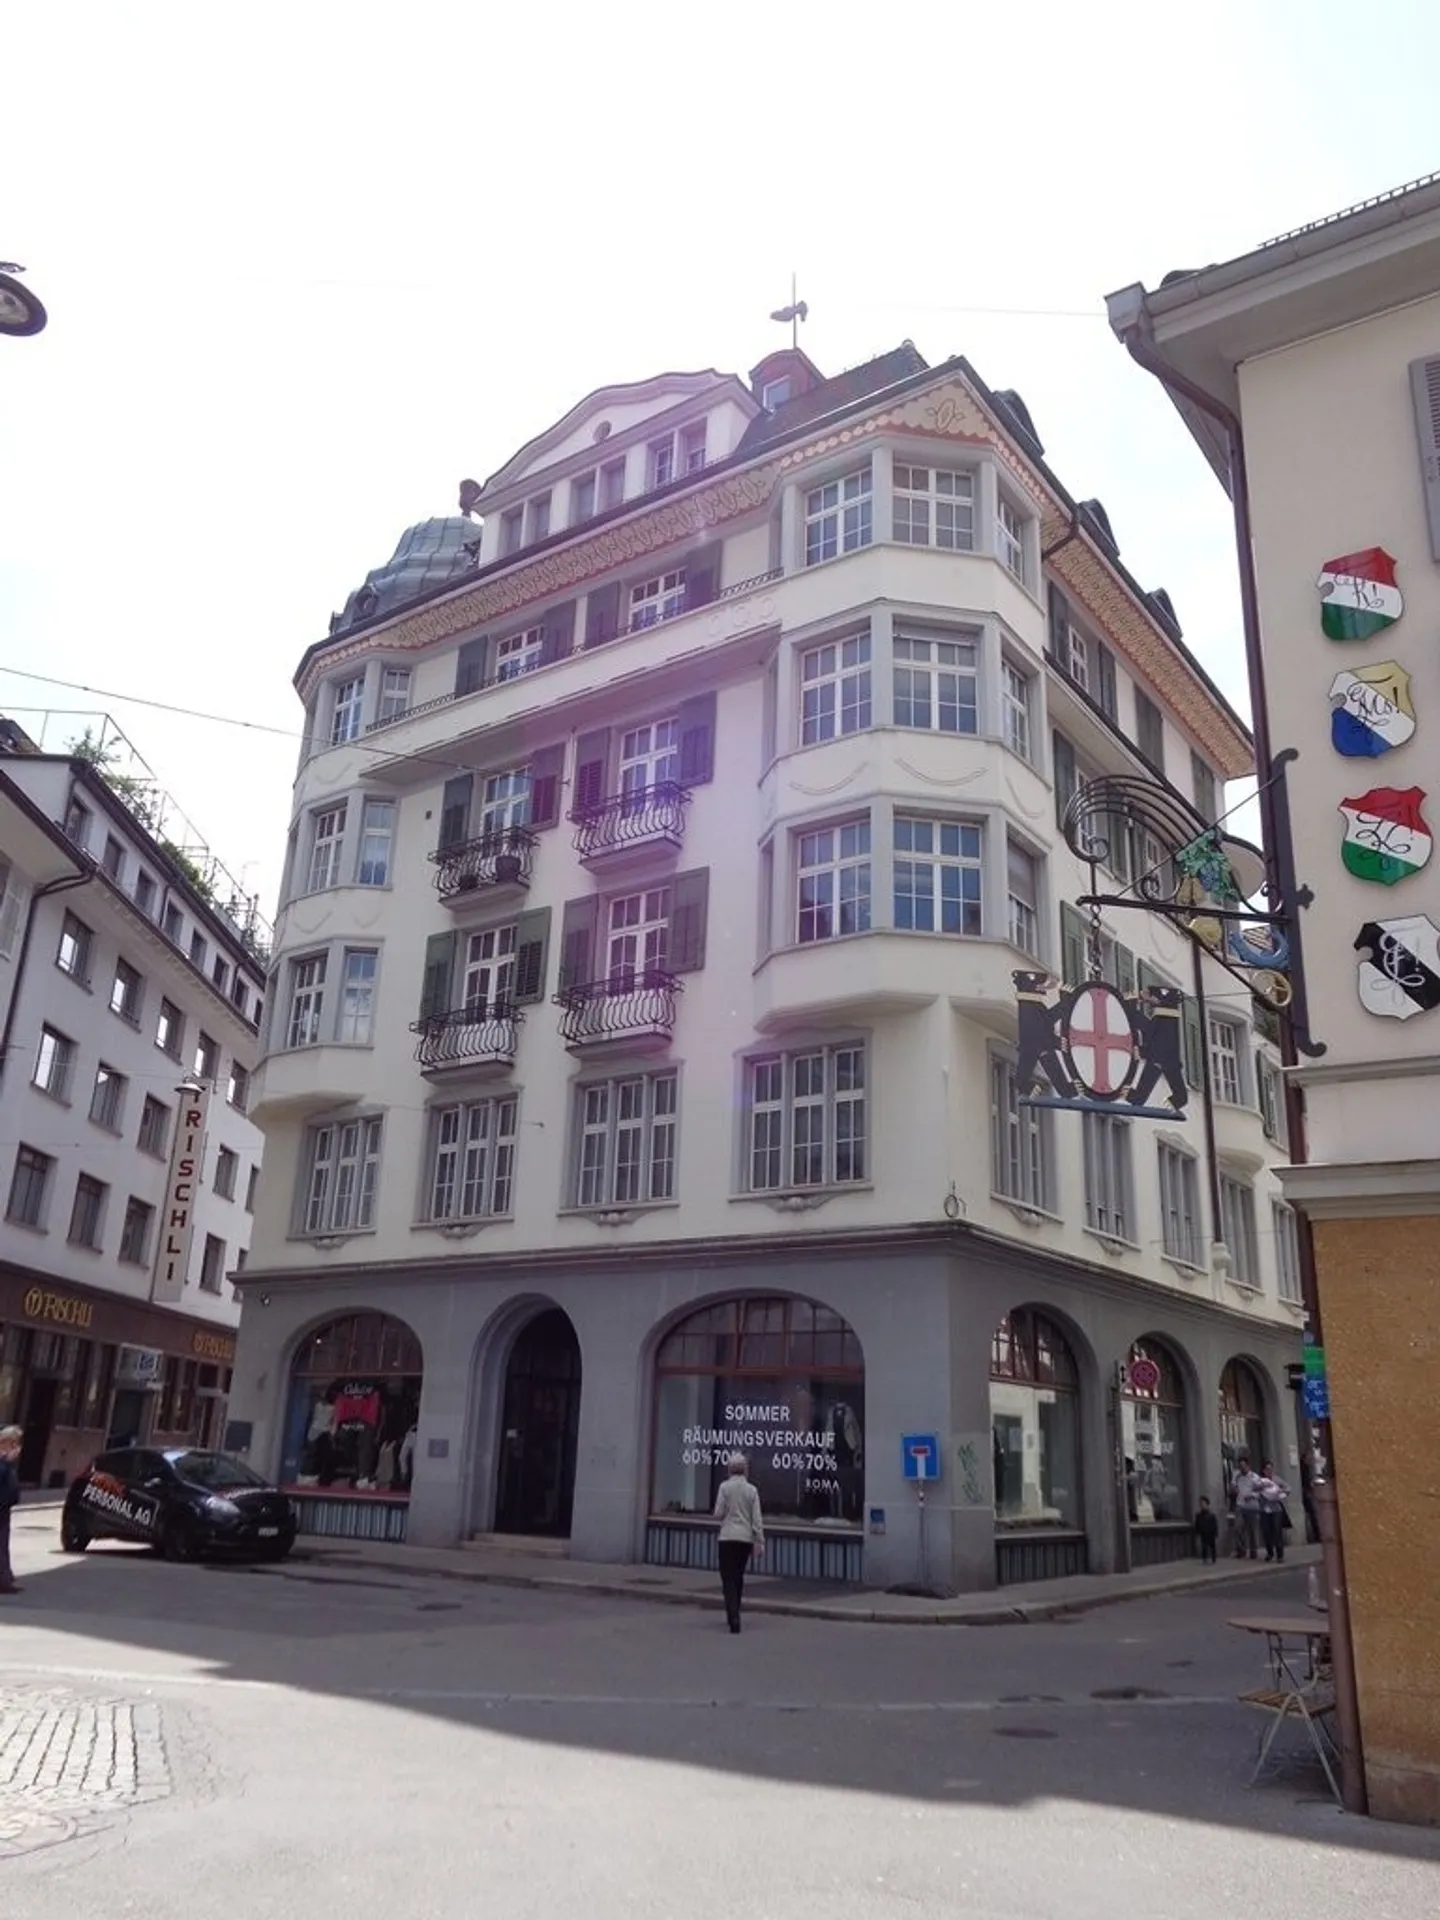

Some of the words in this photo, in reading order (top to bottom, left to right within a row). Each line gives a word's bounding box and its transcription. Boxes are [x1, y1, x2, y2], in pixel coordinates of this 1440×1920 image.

[725, 1404, 791, 1421] SOMMER
[682, 1426, 836, 1448] RÄUMUNGSVERKAUF
[82, 1482, 133, 1520] PERSONAL
